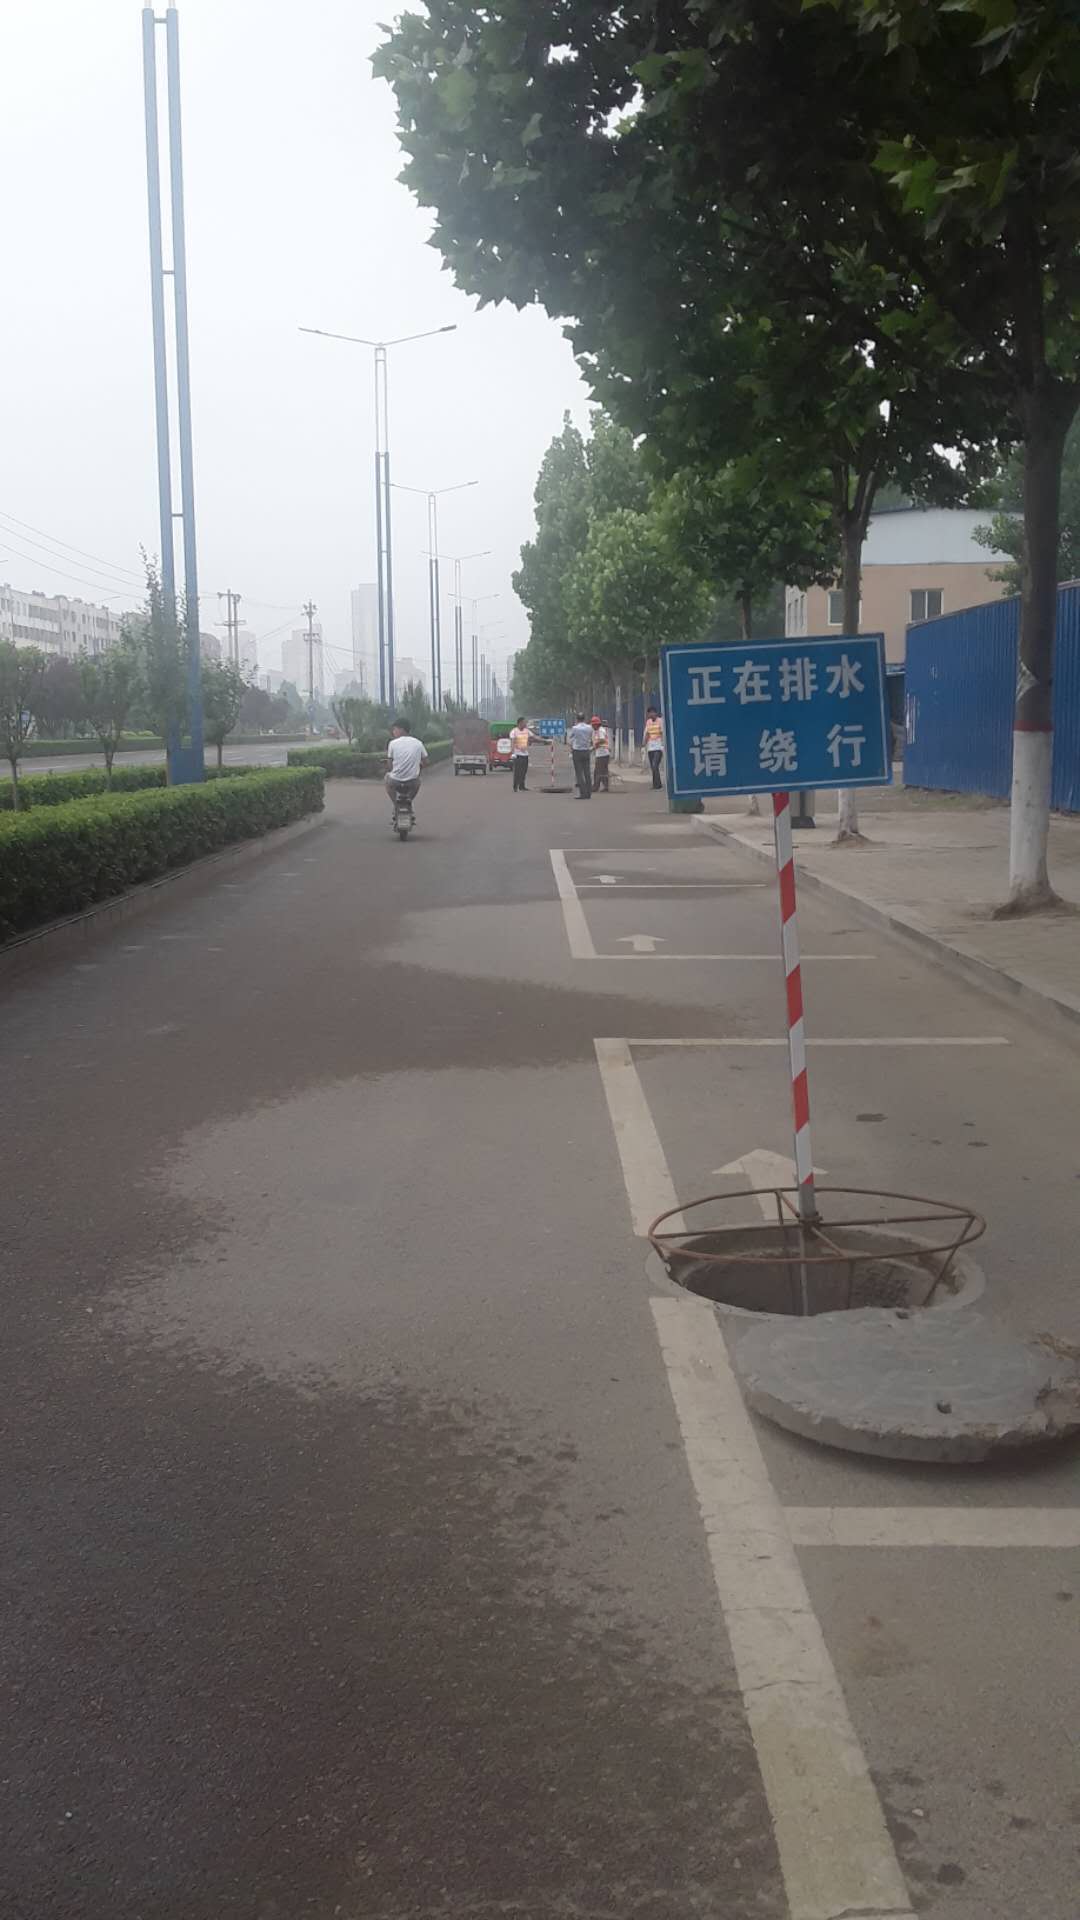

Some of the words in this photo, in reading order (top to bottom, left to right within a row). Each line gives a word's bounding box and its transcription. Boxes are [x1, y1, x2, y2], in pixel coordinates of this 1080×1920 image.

[687, 654, 865, 706] 正在排水
[689, 724, 866, 777] 请绕行
